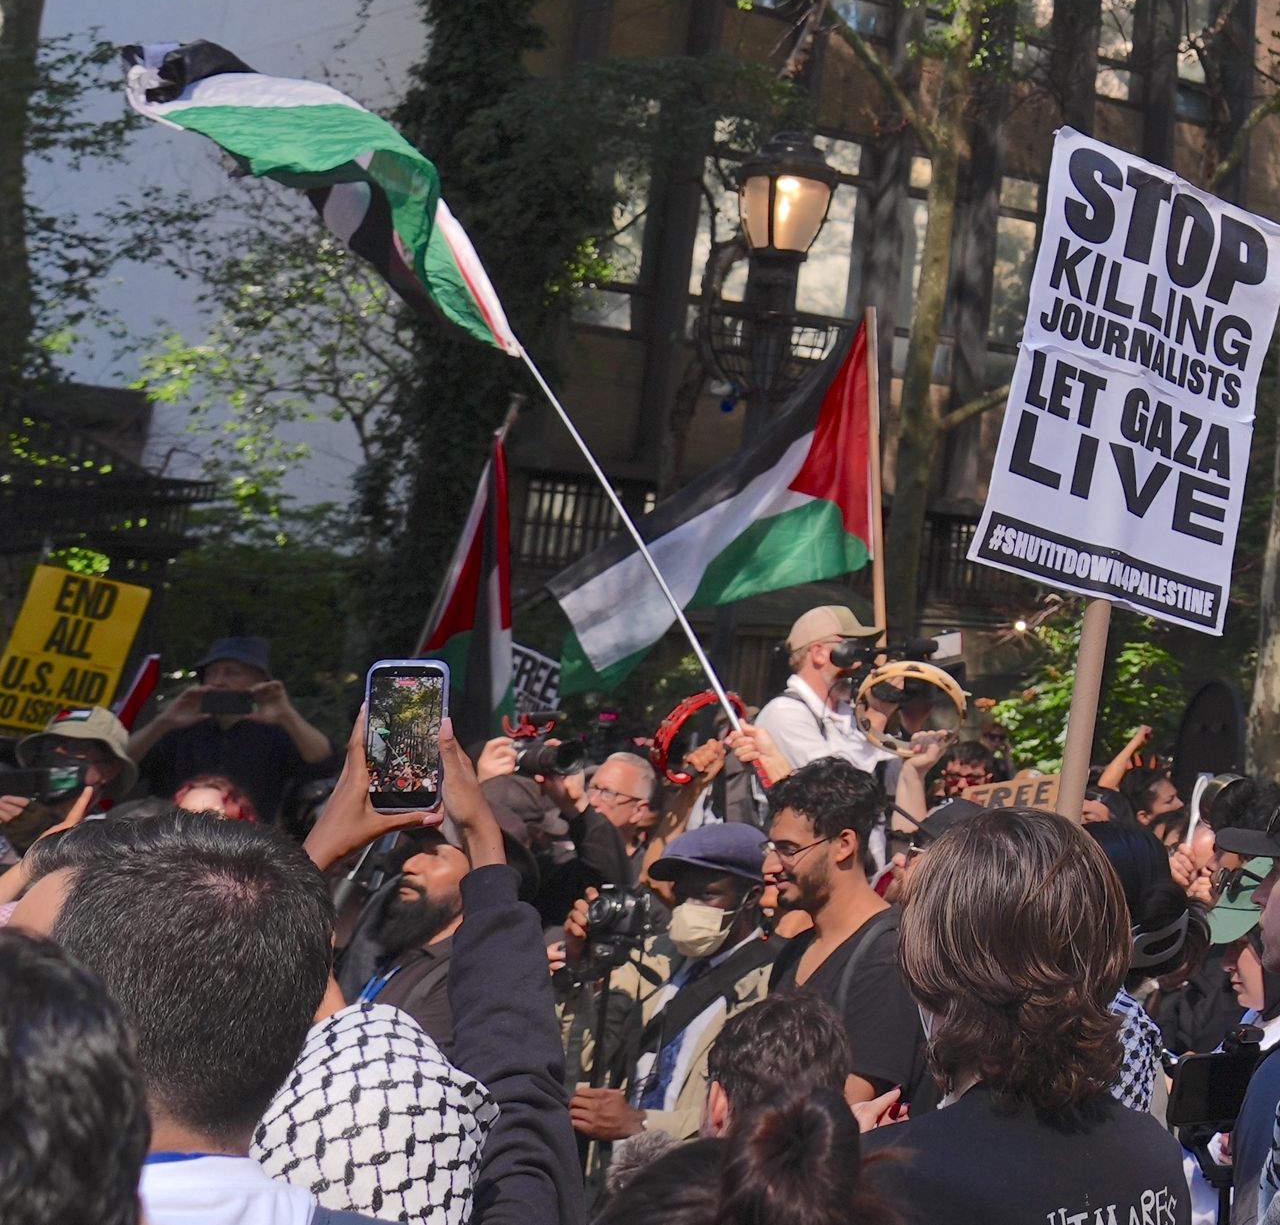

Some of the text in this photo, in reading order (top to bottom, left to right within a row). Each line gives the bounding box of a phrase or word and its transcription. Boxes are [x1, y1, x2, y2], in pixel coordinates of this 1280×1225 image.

[1064, 147, 1268, 305] STOP
[1039, 296, 1242, 409] JOURNALISTS
[1049, 237, 1253, 371] KILLING
[1024, 352, 1231, 481] LET GAZA
[1009, 410, 1230, 546] LIVE
[54, 575, 119, 621] END
[988, 523, 1214, 619] #SHUTITDOWN4PALESTINE
[2, 656, 109, 704] U.S. AID
[43, 615, 95, 660] ALL
